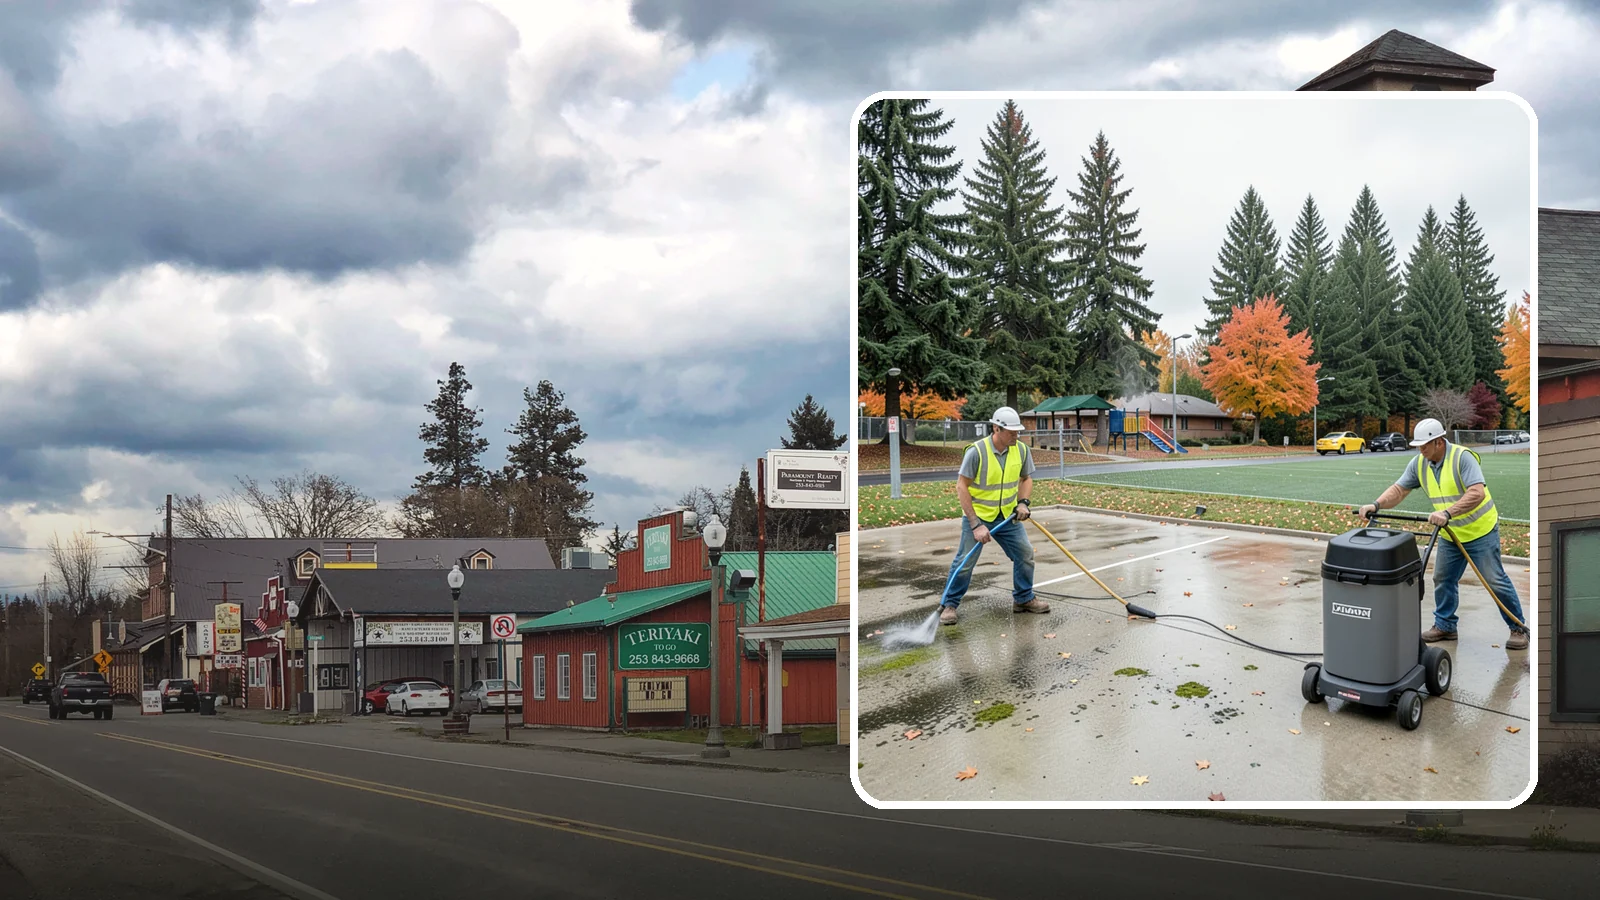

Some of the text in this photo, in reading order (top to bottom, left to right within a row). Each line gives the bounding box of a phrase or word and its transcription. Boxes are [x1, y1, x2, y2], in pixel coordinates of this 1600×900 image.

[781, 471, 839, 480] PARAMOUNT REALTY
[625, 627, 702, 646] TERIYAKI
[628, 653, 700, 665] 253 843-9668
